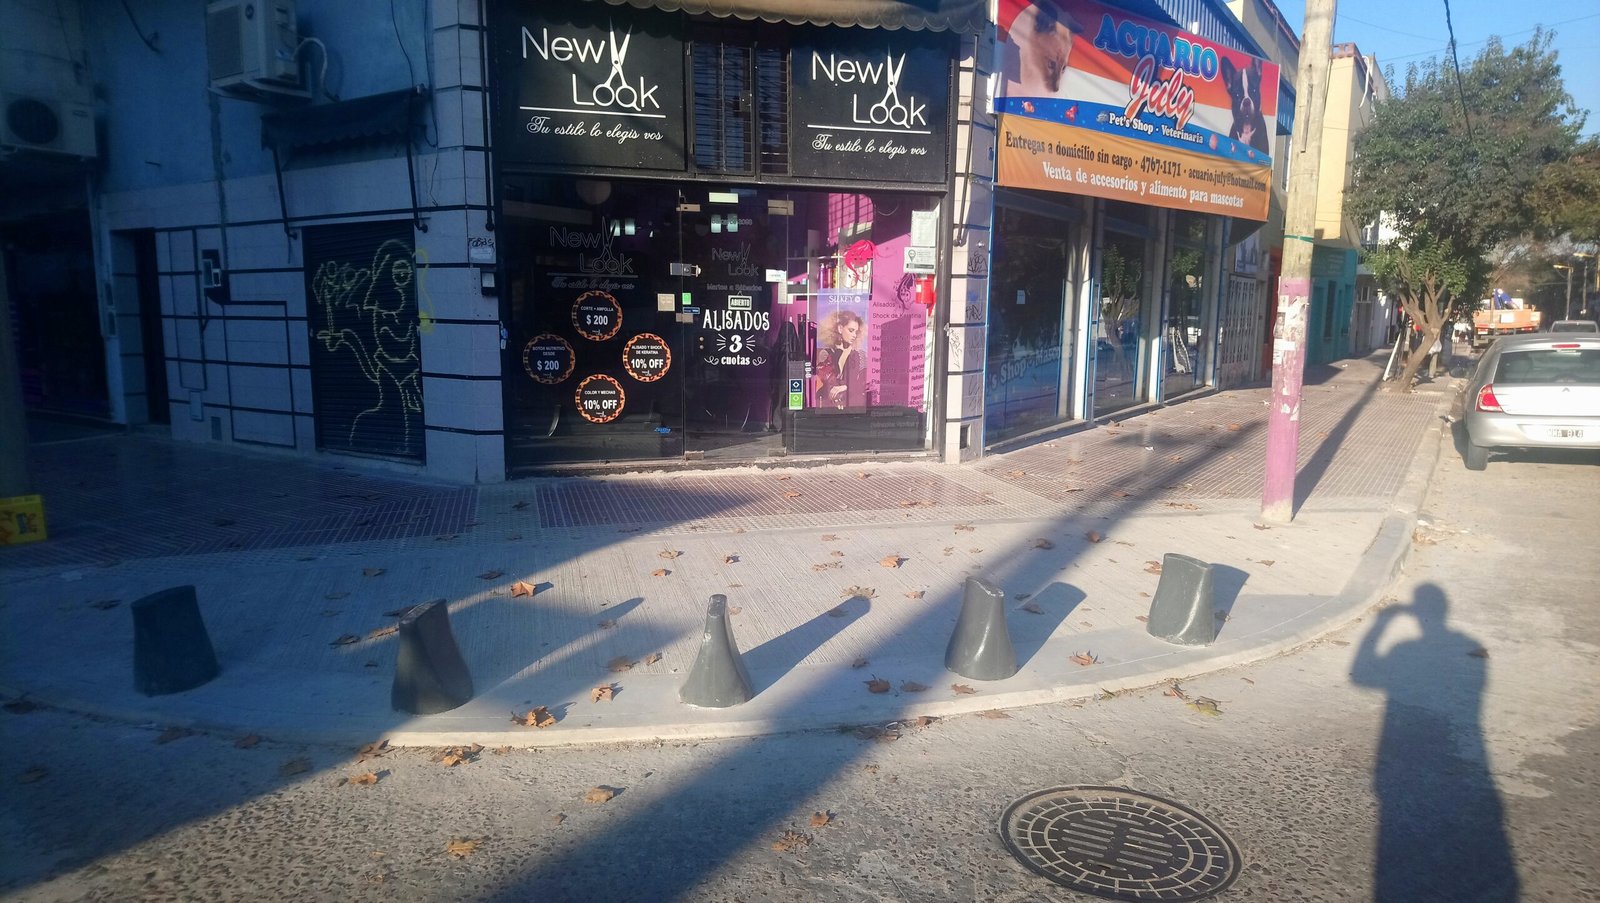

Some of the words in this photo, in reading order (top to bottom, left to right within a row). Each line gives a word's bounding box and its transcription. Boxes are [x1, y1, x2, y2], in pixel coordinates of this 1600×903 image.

[522, 26, 605, 64] New
[1094, 13, 1218, 82] ACUARIO
[812, 50, 883, 84] New
[572, 74, 660, 111] Look
[1125, 54, 1194, 129] July
[853, 94, 926, 128] Look
[526, 116, 551, 134] Tu
[554, 121, 586, 136] estilo
[590, 122, 602, 136] lo
[606, 123, 640, 144] elegis
[644, 131, 664, 140] vos
[1110, 112, 1130, 128] Pet's
[1132, 118, 1153, 135] Shop
[1162, 124, 1203, 144] Veterinaria
[812, 134, 832, 150] Tu
[835, 138, 862, 152] estilo
[864, 139, 876, 153] lo
[879, 140, 908, 159] elegis
[910, 147, 927, 155] vos
[1006, 131, 1045, 155] Entregas
[1048, 142, 1053, 154] a
[1056, 141, 1094, 161] domicilio
[1097, 149, 1109, 164] sin
[1111, 152, 1132, 170] cargo
[1188, 168, 1266, 192] acuario.july@hotmail.com
[1042, 161, 1072, 181] Venta
[1076, 168, 1088, 183] de
[1090, 174, 1138, 192] accesorios
[1141, 181, 1147, 196] y
[1149, 182, 1187, 199] alimento
[1190, 188, 1209, 203] para
[1210, 192, 1244, 208] mascotas
[550, 226, 600, 248] New
[580, 252, 634, 276] Look
[730, 298, 750, 307] ABIERTO
[586, 314, 592, 326] $
[594, 315, 608, 325] 200
[703, 309, 770, 331] ALISADOS
[729, 335, 742, 352] 3
[537, 360, 542, 371] $
[544, 360, 559, 370] 200
[631, 358, 648, 369] 10%
[649, 358, 664, 369] OFF
[721, 354, 750, 366] cuotas
[584, 400, 600, 410] 10%
[602, 400, 617, 410] OFF
